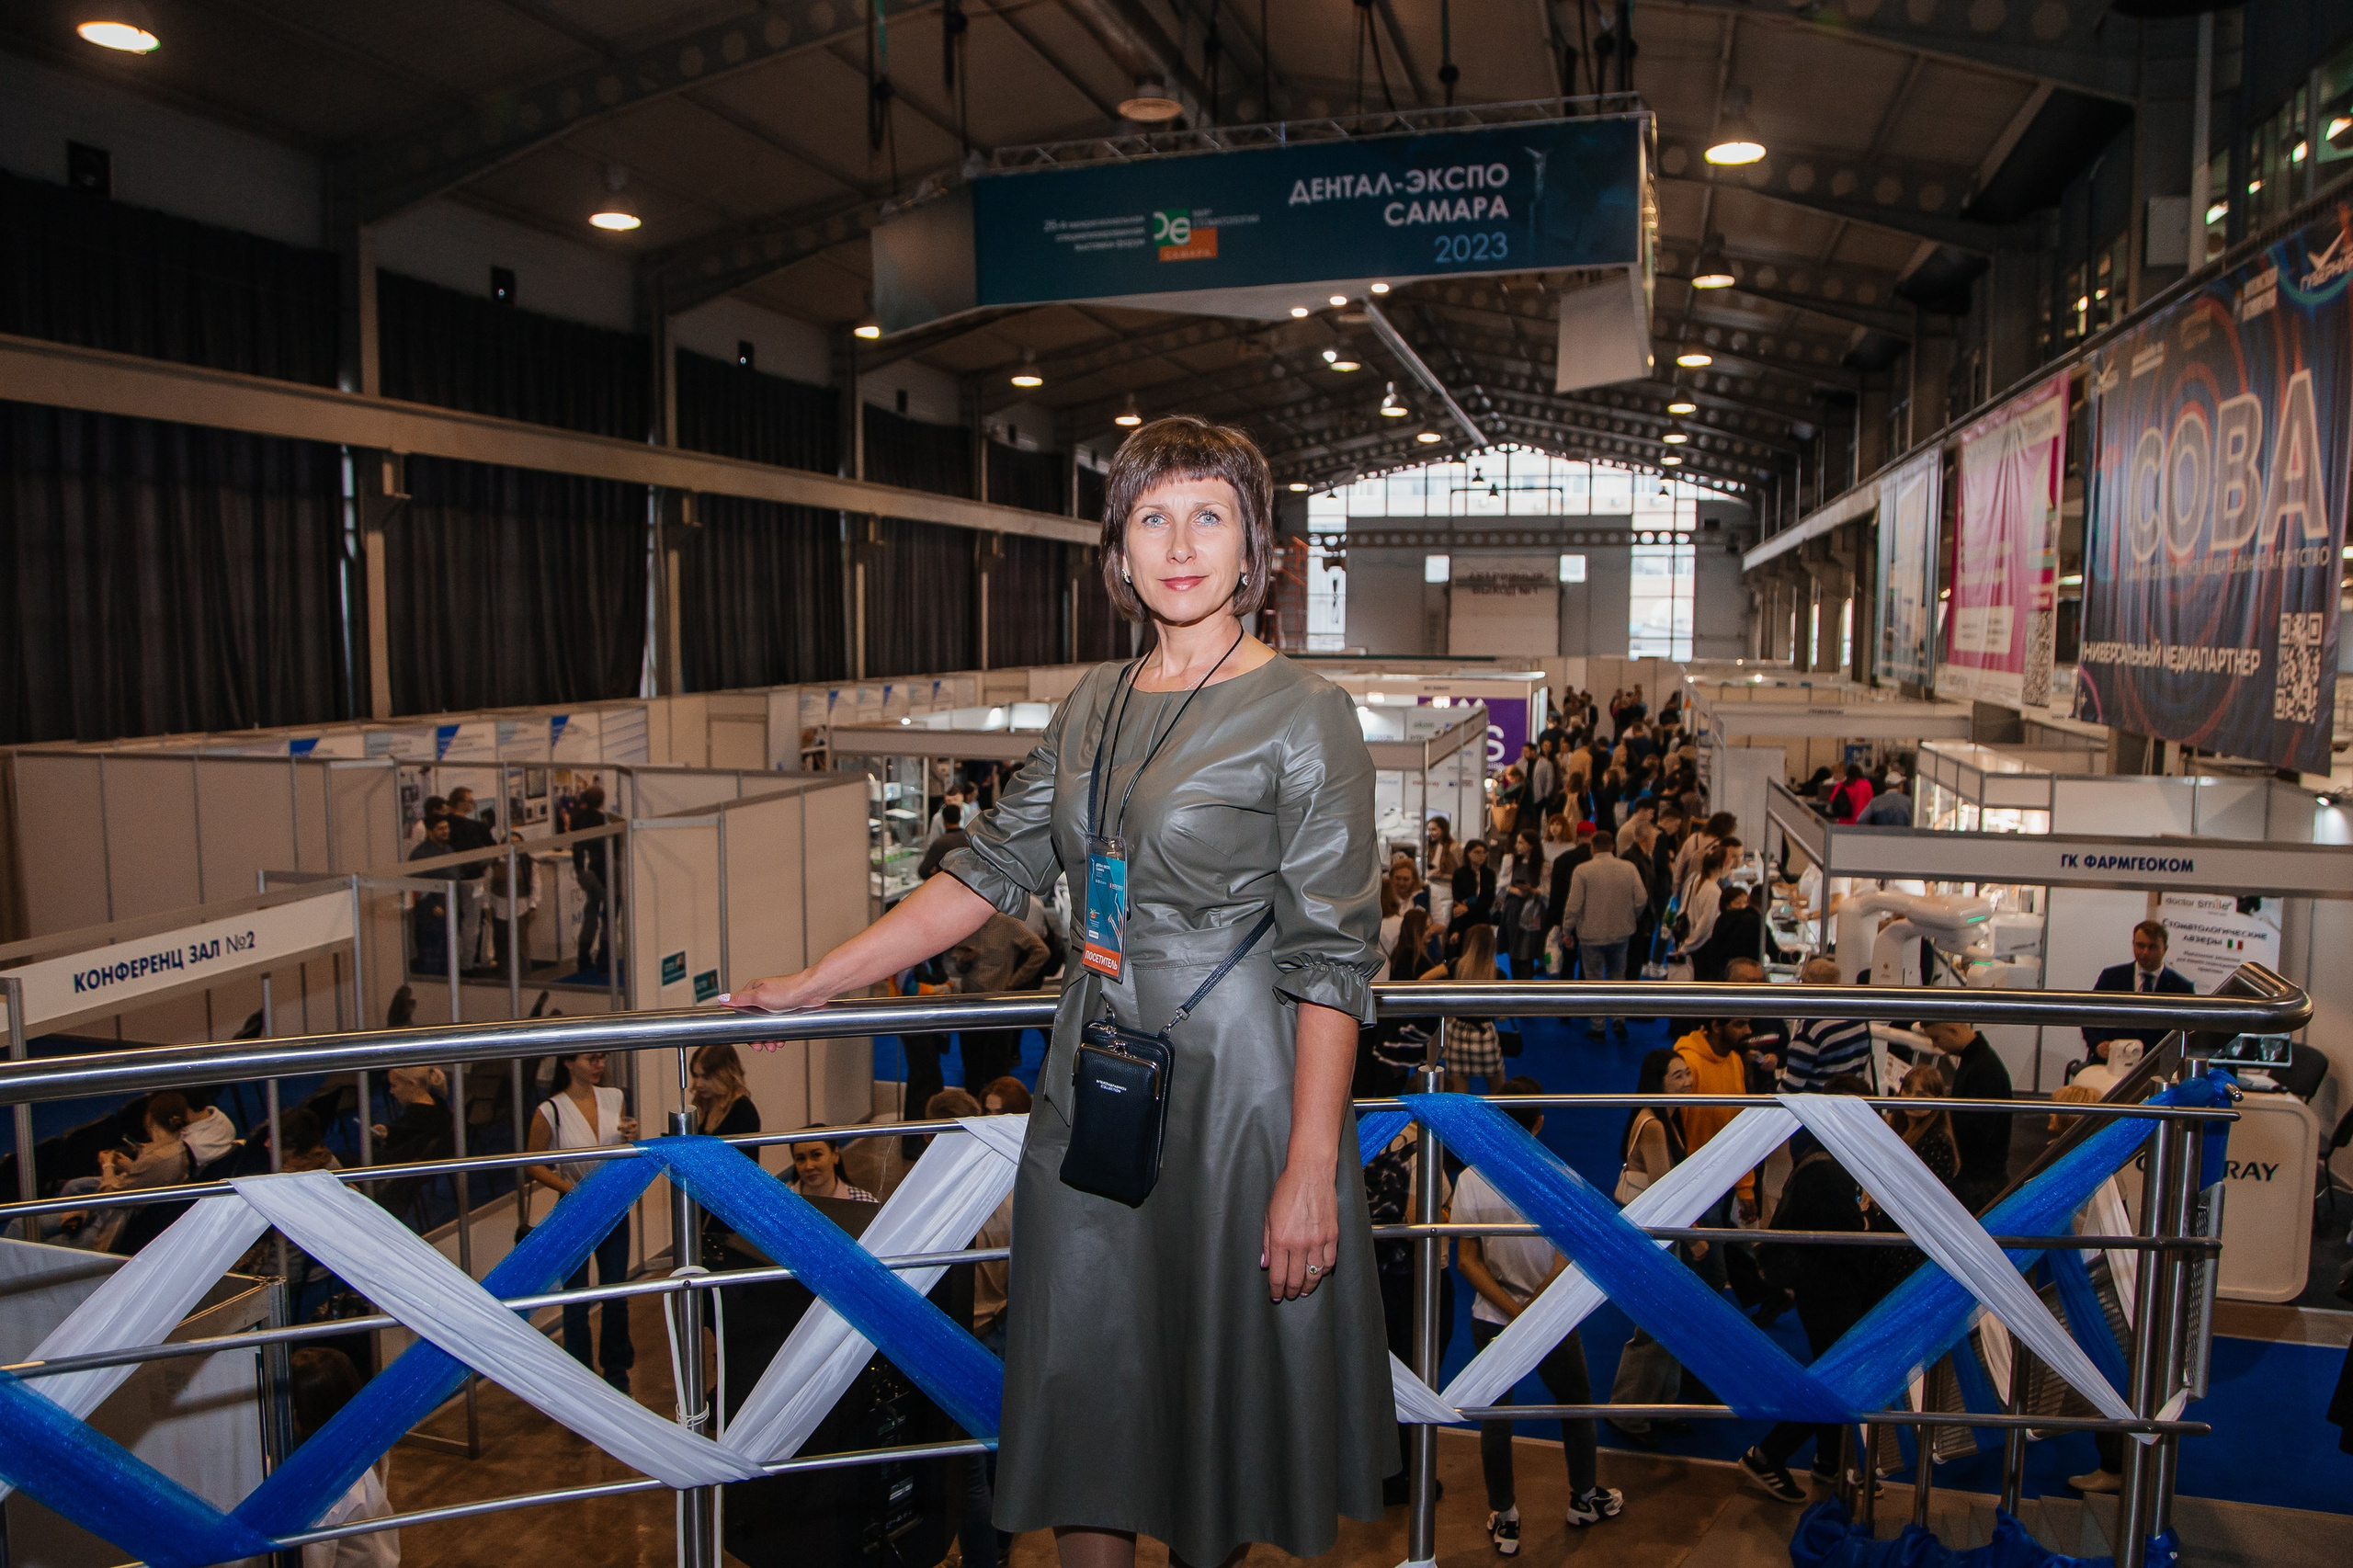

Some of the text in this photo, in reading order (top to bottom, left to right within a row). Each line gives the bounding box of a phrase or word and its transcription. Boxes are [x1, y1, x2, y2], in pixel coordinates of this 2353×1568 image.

[1289, 163, 1509, 206] ДЕНТАЛ-ЭКСПО
[1383, 195, 1509, 227] САМАРА
[1434, 232, 1508, 264] 2023
[2128, 368, 2328, 562] СОВА
[2162, 645, 2261, 677] МЕДИАПАРТНЕР
[2061, 853, 2194, 872] ГК ФАРМГЕОКОМ
[2165, 896, 2230, 910] doctor smile
[74, 930, 256, 994] КОНФЕРЕНЦ ЗАЛ №2
[1085, 949, 1119, 971] ПОСЕТИТЕЛЬ
